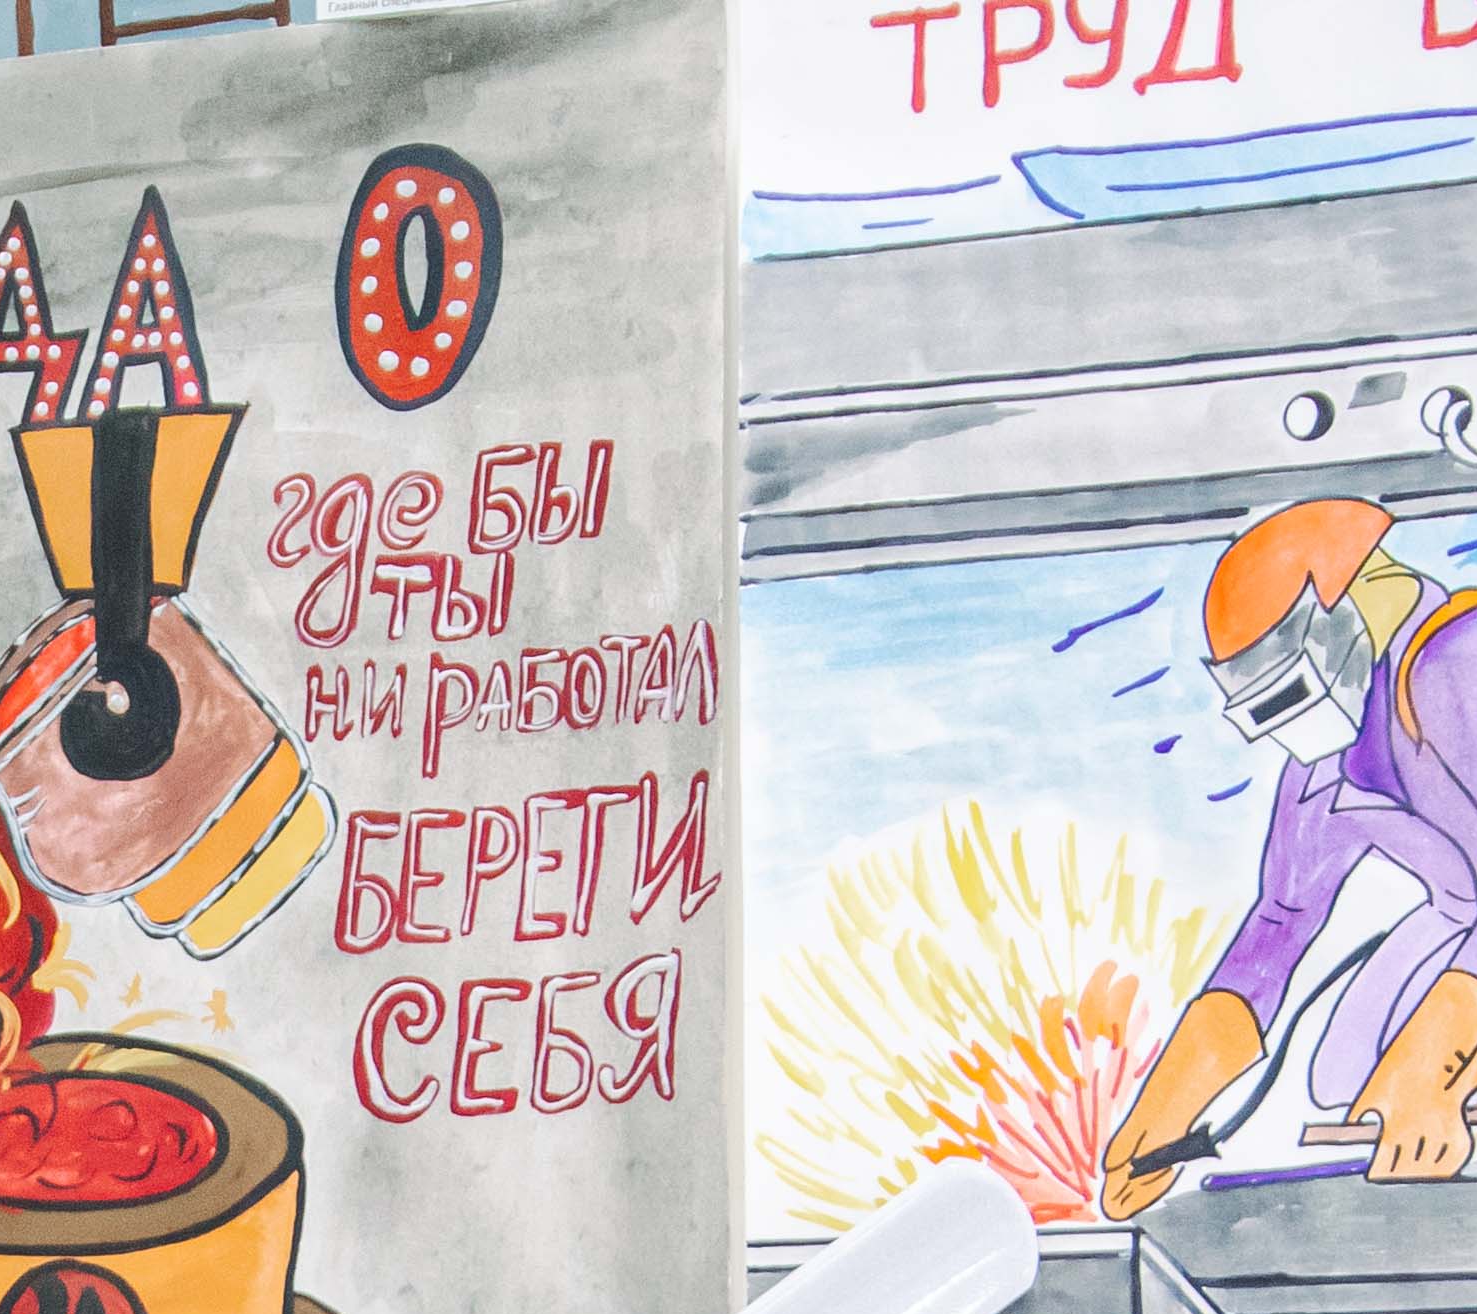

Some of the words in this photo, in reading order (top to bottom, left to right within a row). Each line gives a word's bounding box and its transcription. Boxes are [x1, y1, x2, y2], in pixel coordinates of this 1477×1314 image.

[336, 142, 503, 410] О
[335, 769, 722, 957] БЕРЕГИ
[352, 949, 685, 1123] СЕБЯ
